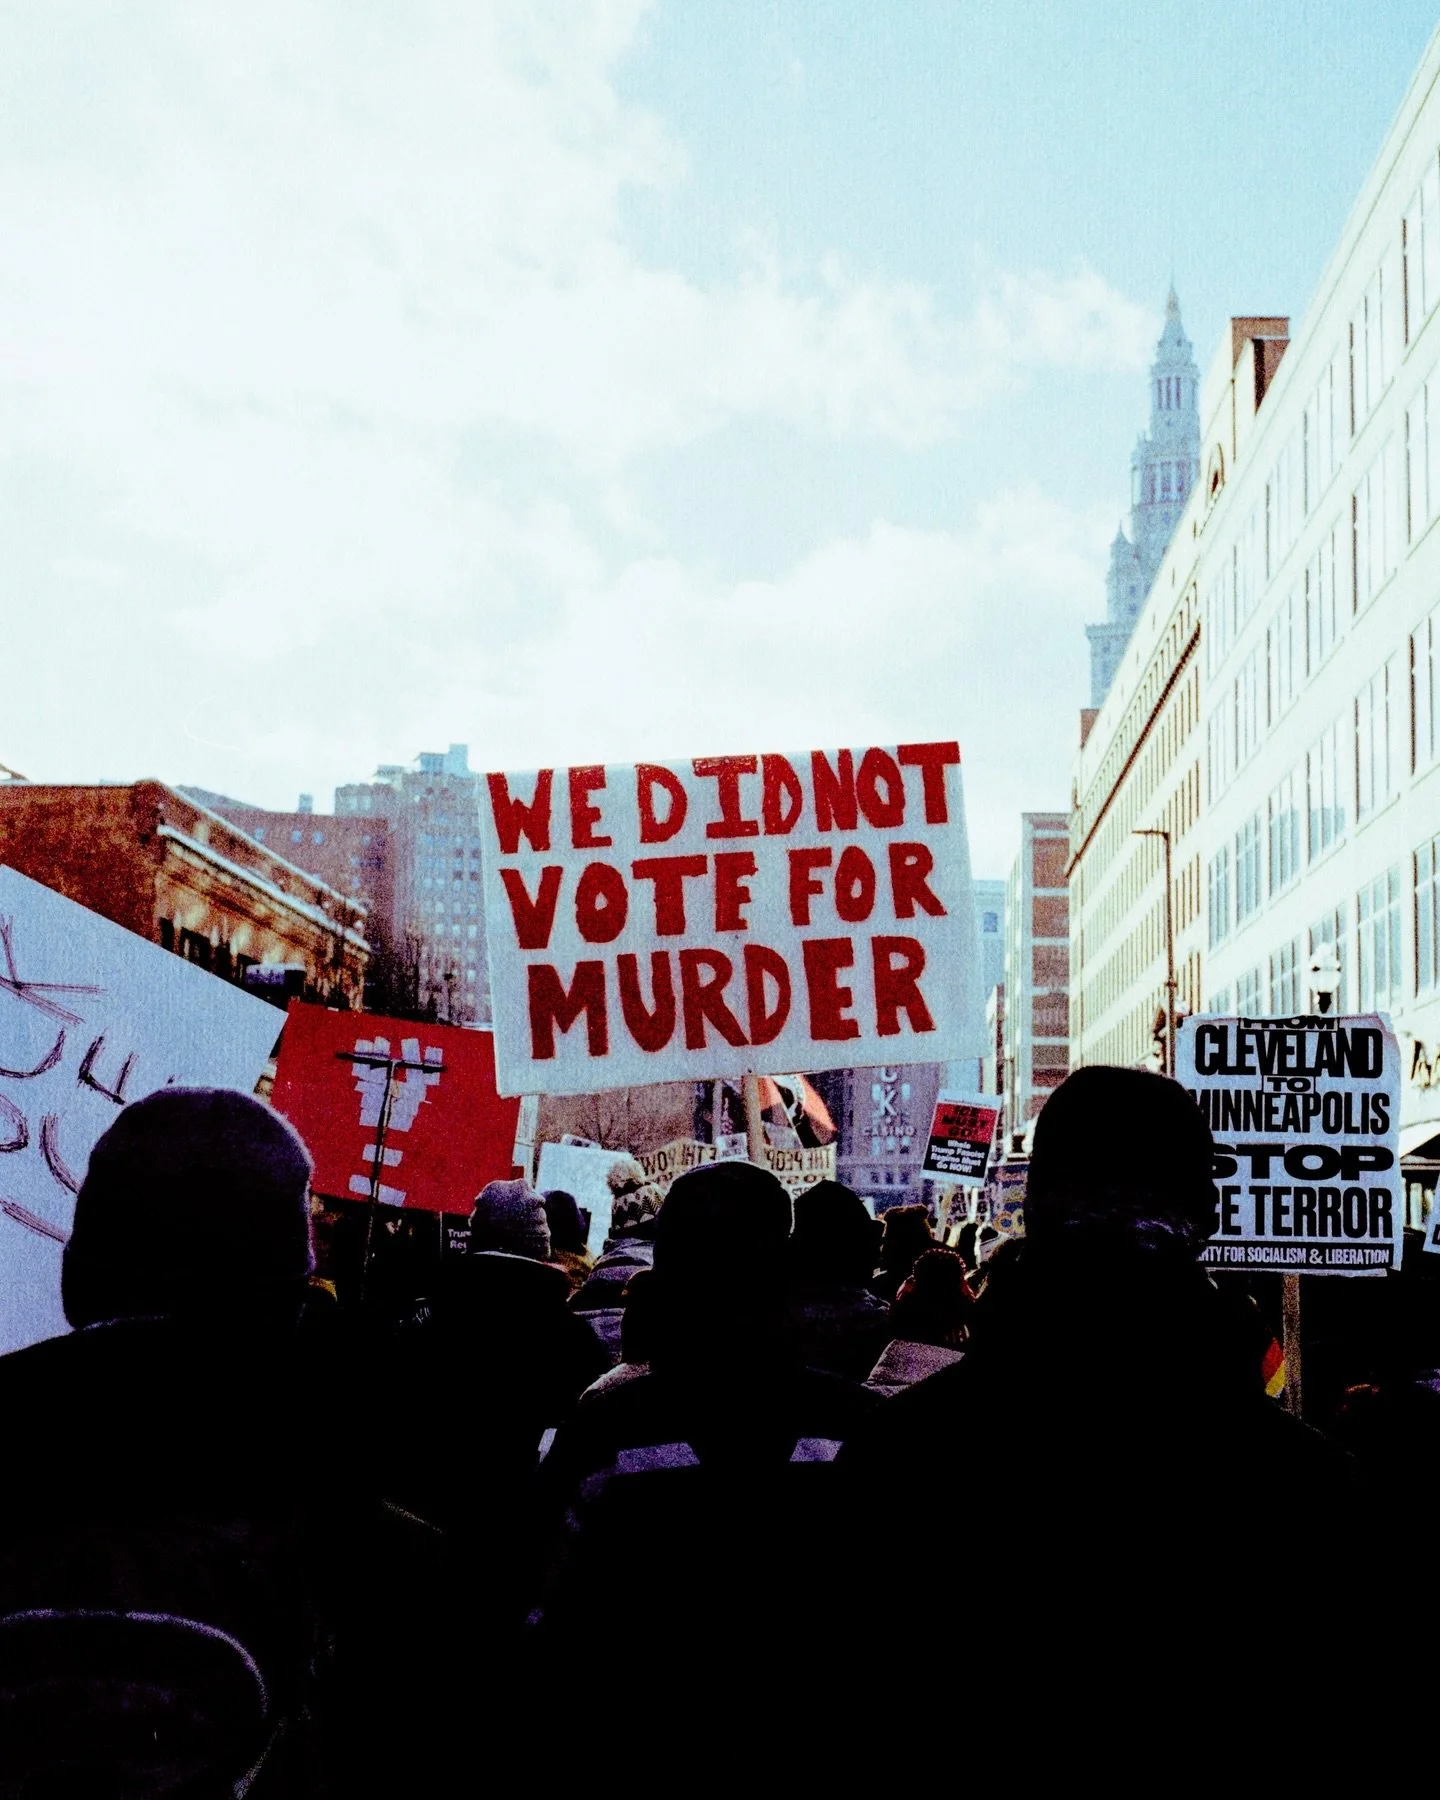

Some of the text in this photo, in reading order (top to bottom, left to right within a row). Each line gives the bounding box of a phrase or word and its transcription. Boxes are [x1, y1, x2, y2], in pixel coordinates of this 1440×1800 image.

[487, 764, 612, 854] WE
[498, 842, 948, 950] VOTE FOR
[527, 935, 937, 1060] MURDER
[1194, 1024, 1383, 1078] CLEVELAND
[1266, 1077, 1312, 1092] TO
[931, 1145, 956, 1157] Trump
[1248, 1185, 1394, 1239] TERROR
[1224, 1246, 1245, 1262] FOR
[1246, 1246, 1306, 1263] SOCIALISM
[1309, 1248, 1323, 1264] &
[1325, 1249, 1390, 1264] LIBERATION
